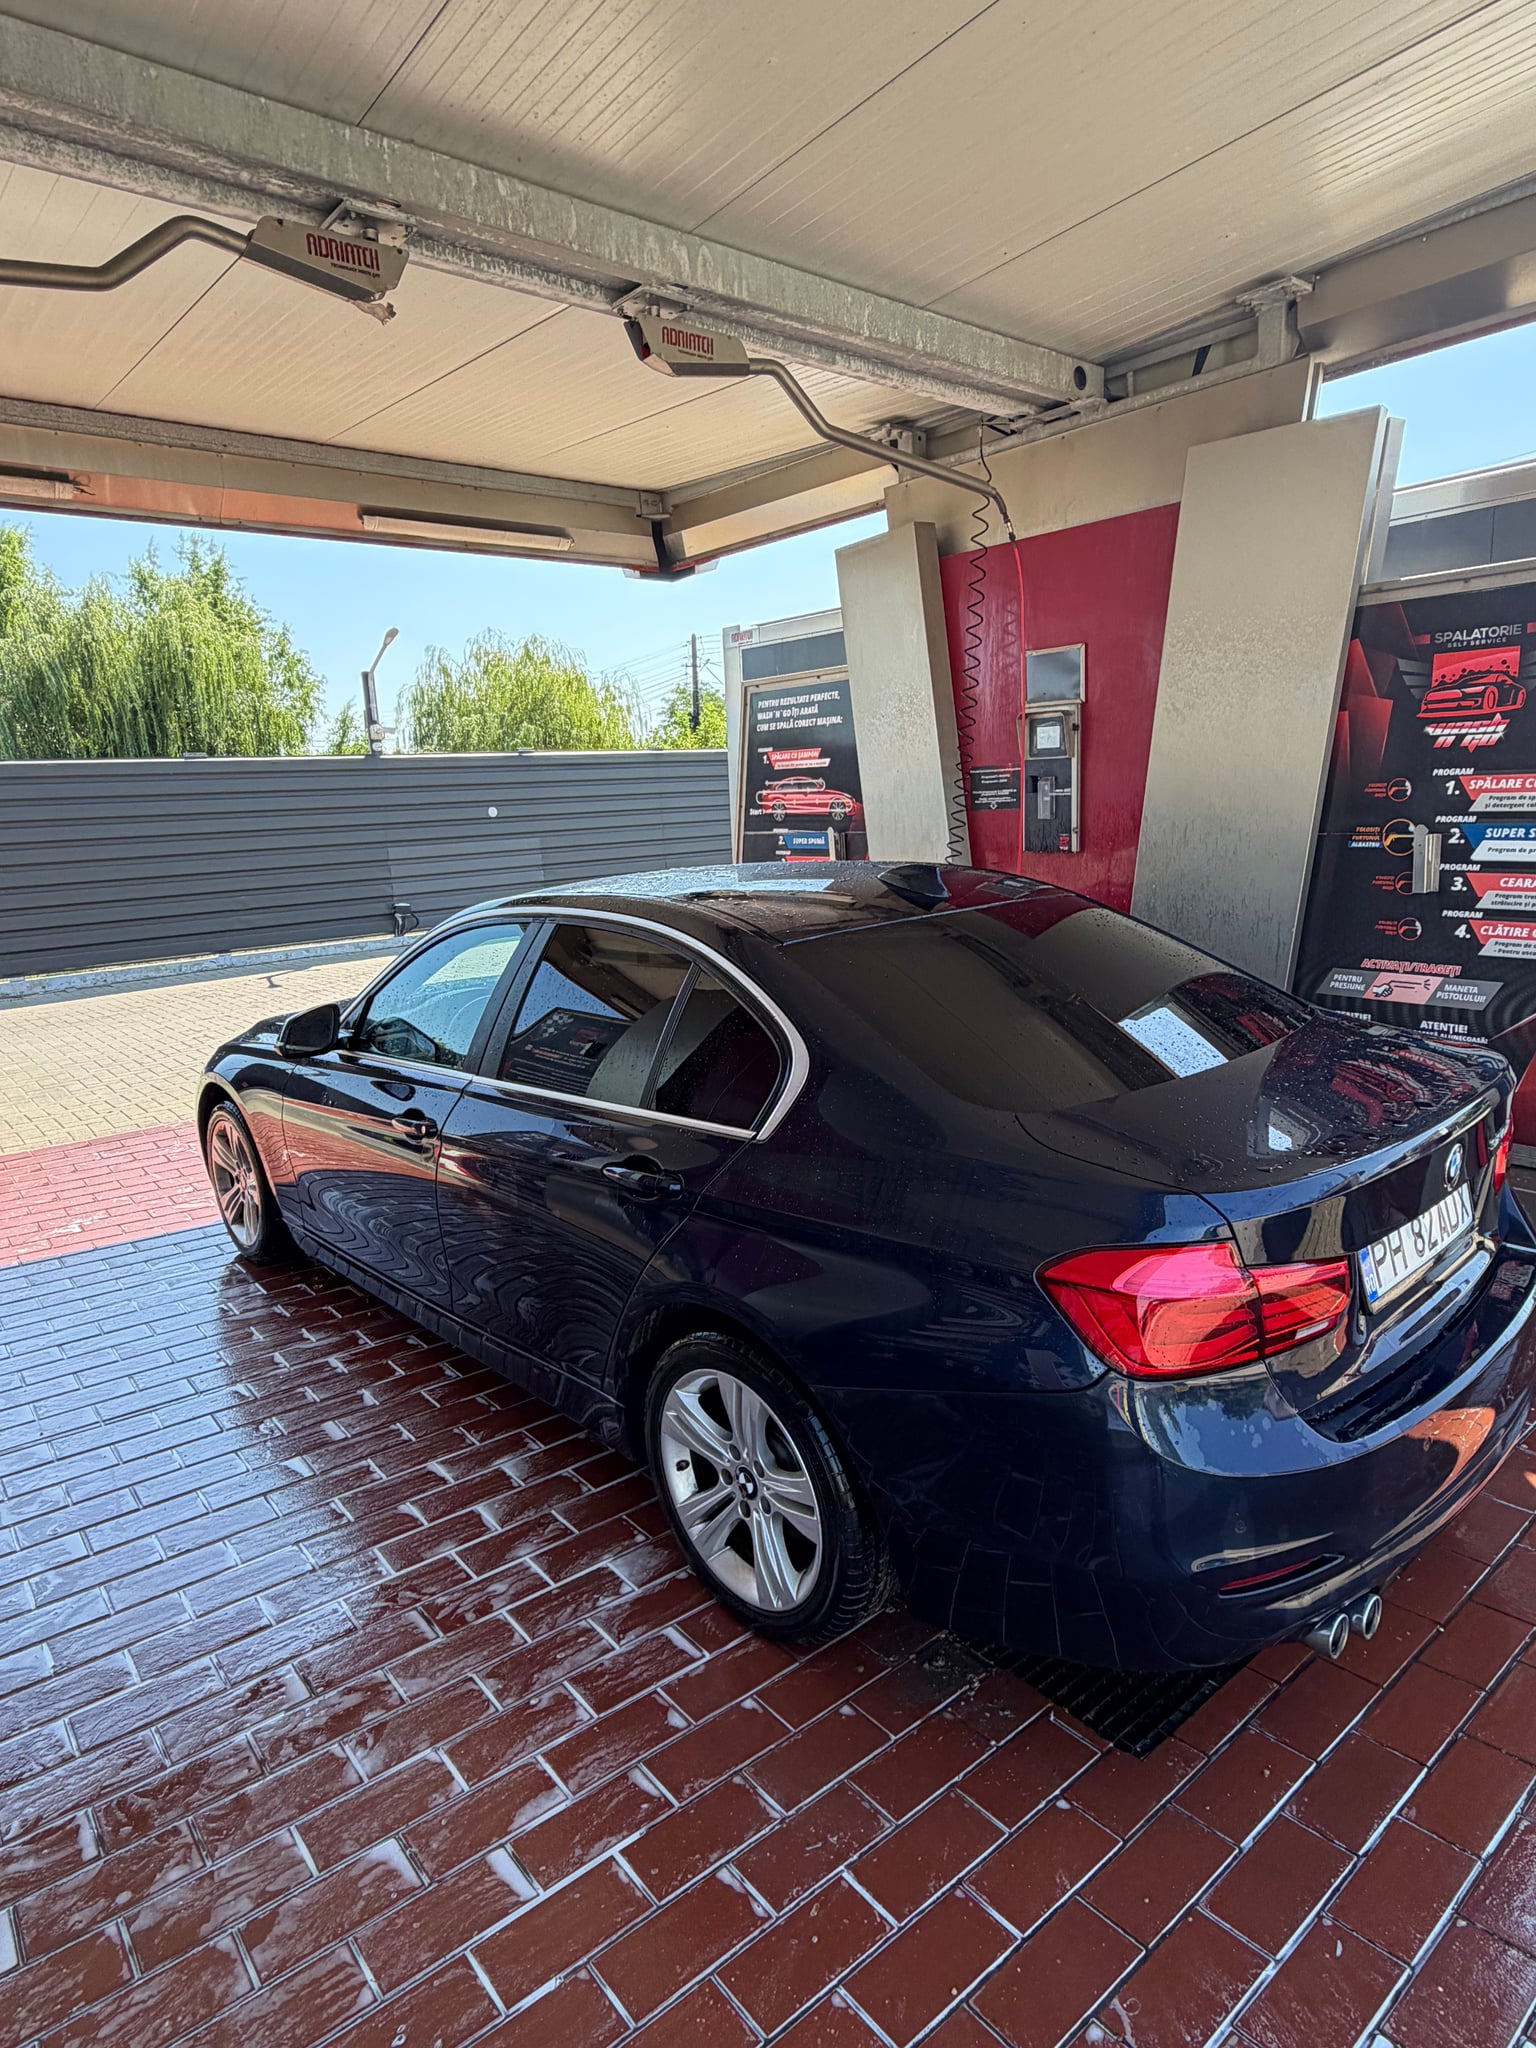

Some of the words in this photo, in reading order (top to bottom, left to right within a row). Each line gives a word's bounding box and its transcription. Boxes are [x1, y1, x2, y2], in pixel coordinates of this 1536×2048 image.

[1434, 624, 1523, 644] SPALATORIE
[1447, 640, 1468, 648] SELF
[1470, 637, 1507, 646] SERVICE
[758, 699, 780, 709] PENTRU
[809, 690, 841, 702] PERFECTE,
[756, 723, 769, 732] CUM
[1432, 768, 1475, 776] PROGRAM
[1445, 780, 1460, 795] 1.
[1468, 776, 1524, 790] SPĂLARE
[1435, 815, 1477, 823] PROGRAM
[1448, 827, 1466, 844] 2.
[1484, 828, 1526, 838] SUPER
[1439, 863, 1481, 871] PROGRAM
[1450, 877, 1468, 892] 3.
[1441, 910, 1484, 919] PROGRAM
[1454, 924, 1471, 939] 4.
[1480, 924, 1530, 938] CLĂTIRE
[1333, 974, 1363, 983] PENTRU
[1329, 981, 1366, 992] PRESIUNE
[1444, 984, 1479, 994] MANETA
[1435, 992, 1487, 1003] PISTOLULUI!
[1371, 1228, 1409, 1289] PH
